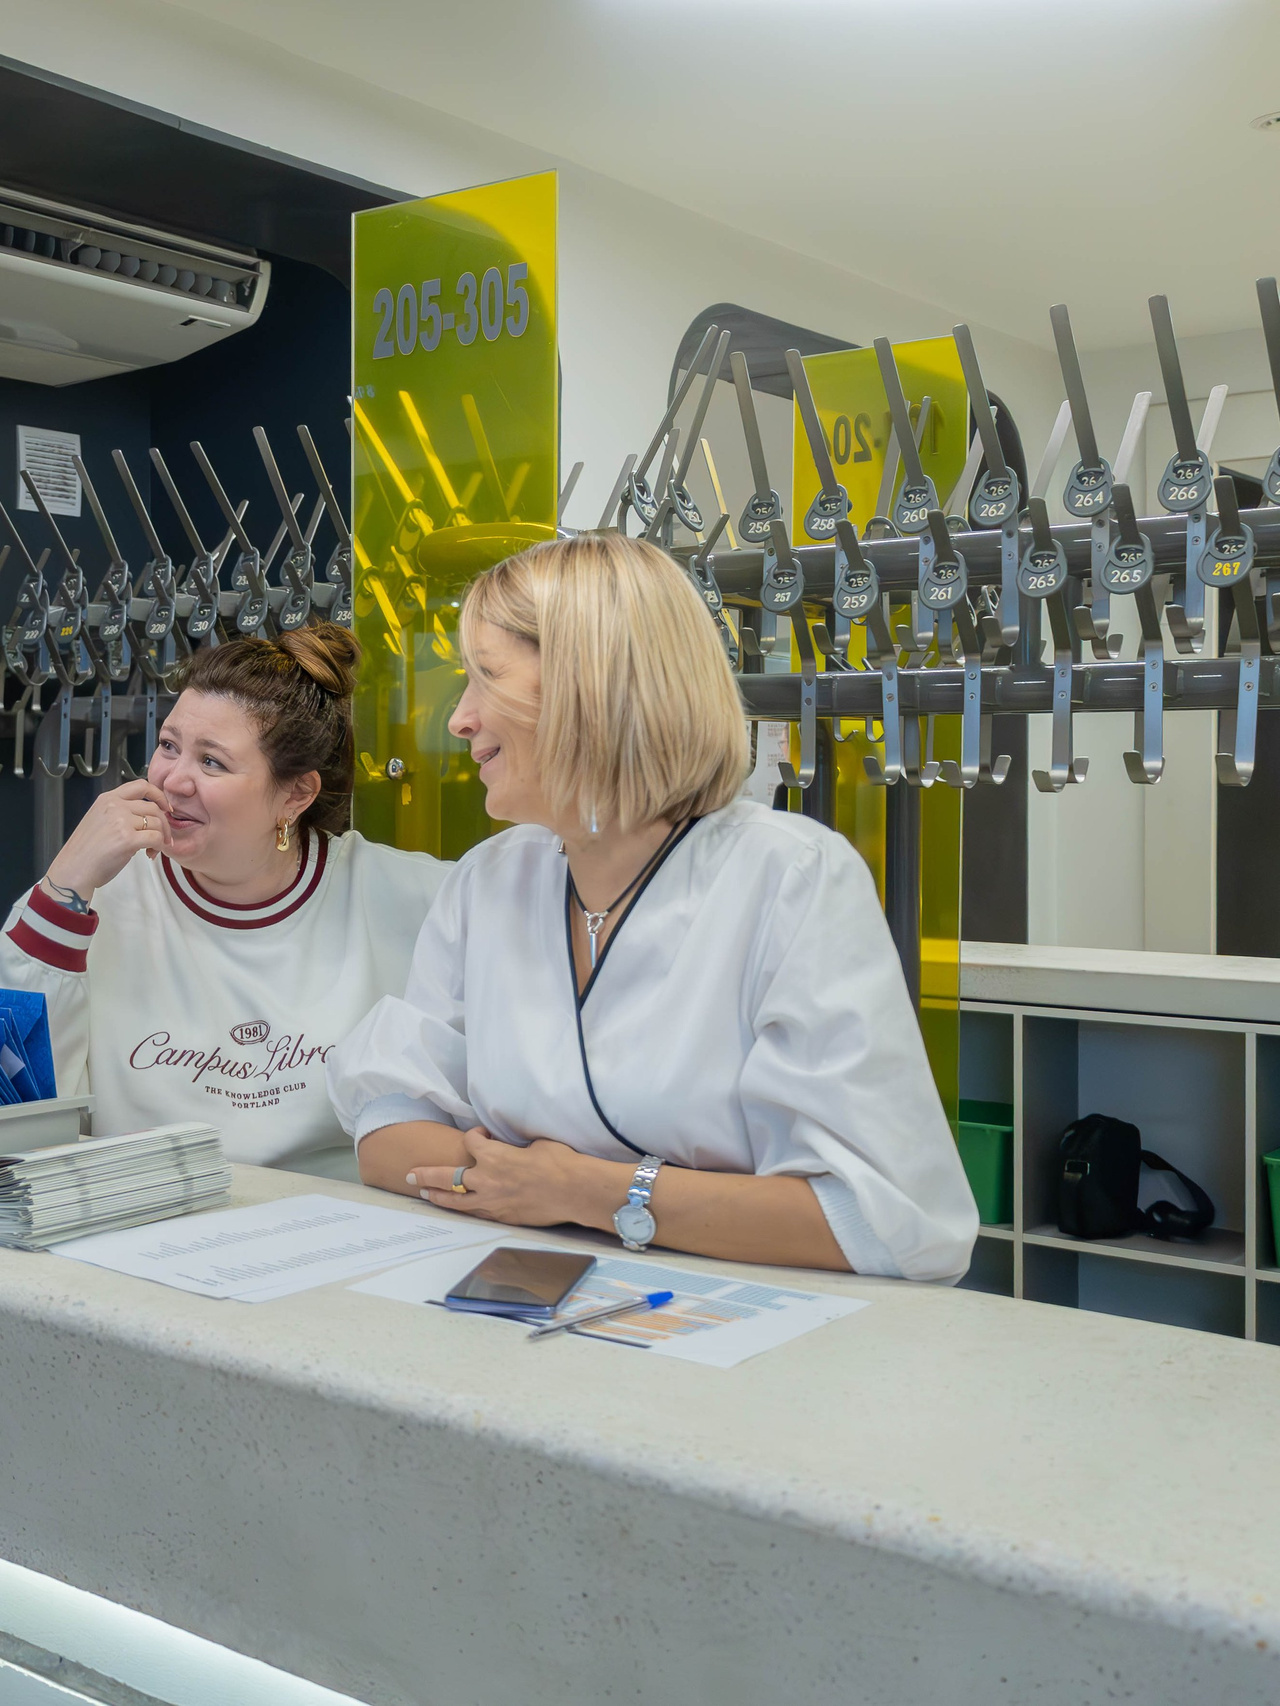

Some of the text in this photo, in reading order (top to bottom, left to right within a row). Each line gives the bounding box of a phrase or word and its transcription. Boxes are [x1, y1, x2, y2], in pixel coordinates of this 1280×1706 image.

[372, 262, 529, 359] 205-305
[1075, 491, 1104, 507] 264
[1168, 486, 1198, 500] 266
[902, 508, 928, 523] 260
[980, 502, 1006, 516] 262
[748, 521, 771, 533] 256
[811, 518, 836, 530] 258
[1110, 569, 1142, 583] 265
[1212, 562, 1241, 576] 267
[1028, 574, 1056, 589] 263
[773, 592, 791, 602] 257
[929, 586, 953, 600] 261
[842, 595, 868, 609] 259
[242, 616, 258, 625] 232
[284, 612, 302, 624] 234
[103, 625, 119, 635] 226
[150, 624, 166, 633] 228
[239, 1024, 263, 1040] 1981
[129, 1031, 258, 1083] Campus
[205, 1082, 307, 1100] THE KNOWLEDGE CLUB
[231, 1097, 280, 1109] PORTLAND
